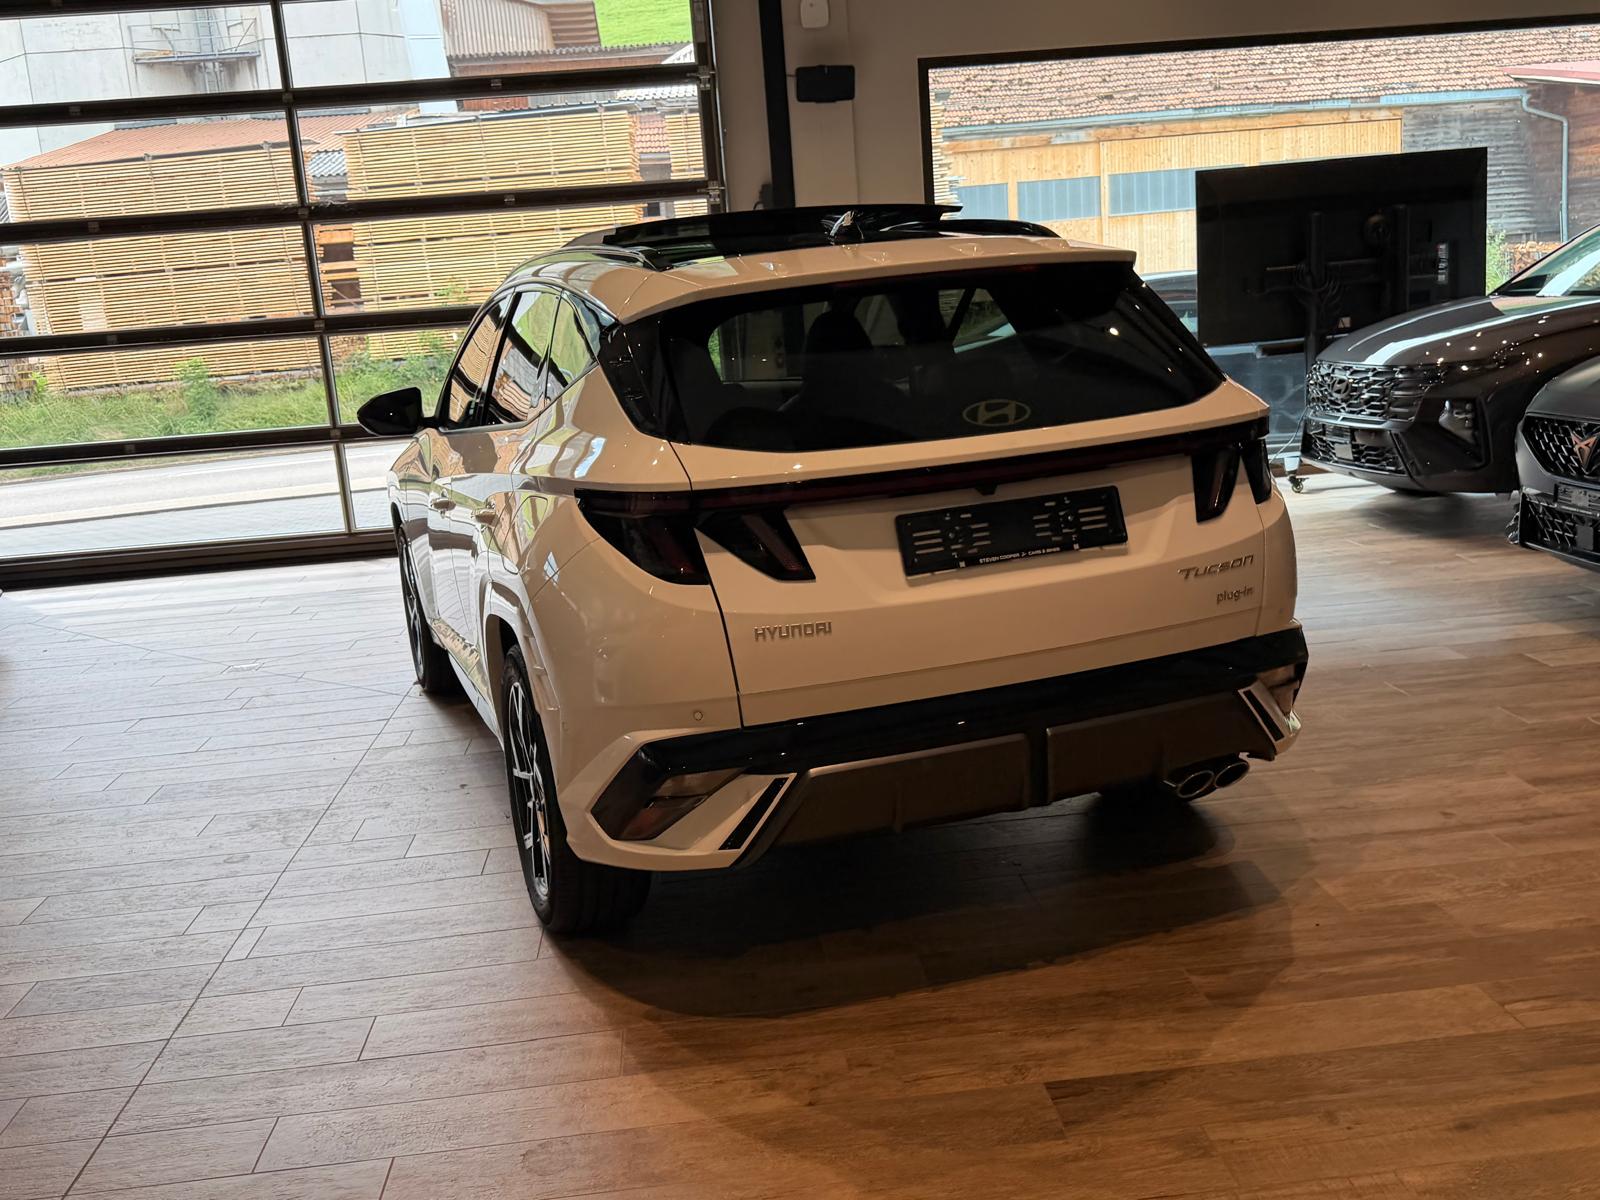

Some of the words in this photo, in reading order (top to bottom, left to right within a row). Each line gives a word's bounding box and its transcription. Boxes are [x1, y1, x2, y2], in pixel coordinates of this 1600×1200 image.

[979, 556, 999, 564] STEVEN
[1216, 585, 1254, 605] plug-in
[754, 620, 832, 642] HYUNDAI
